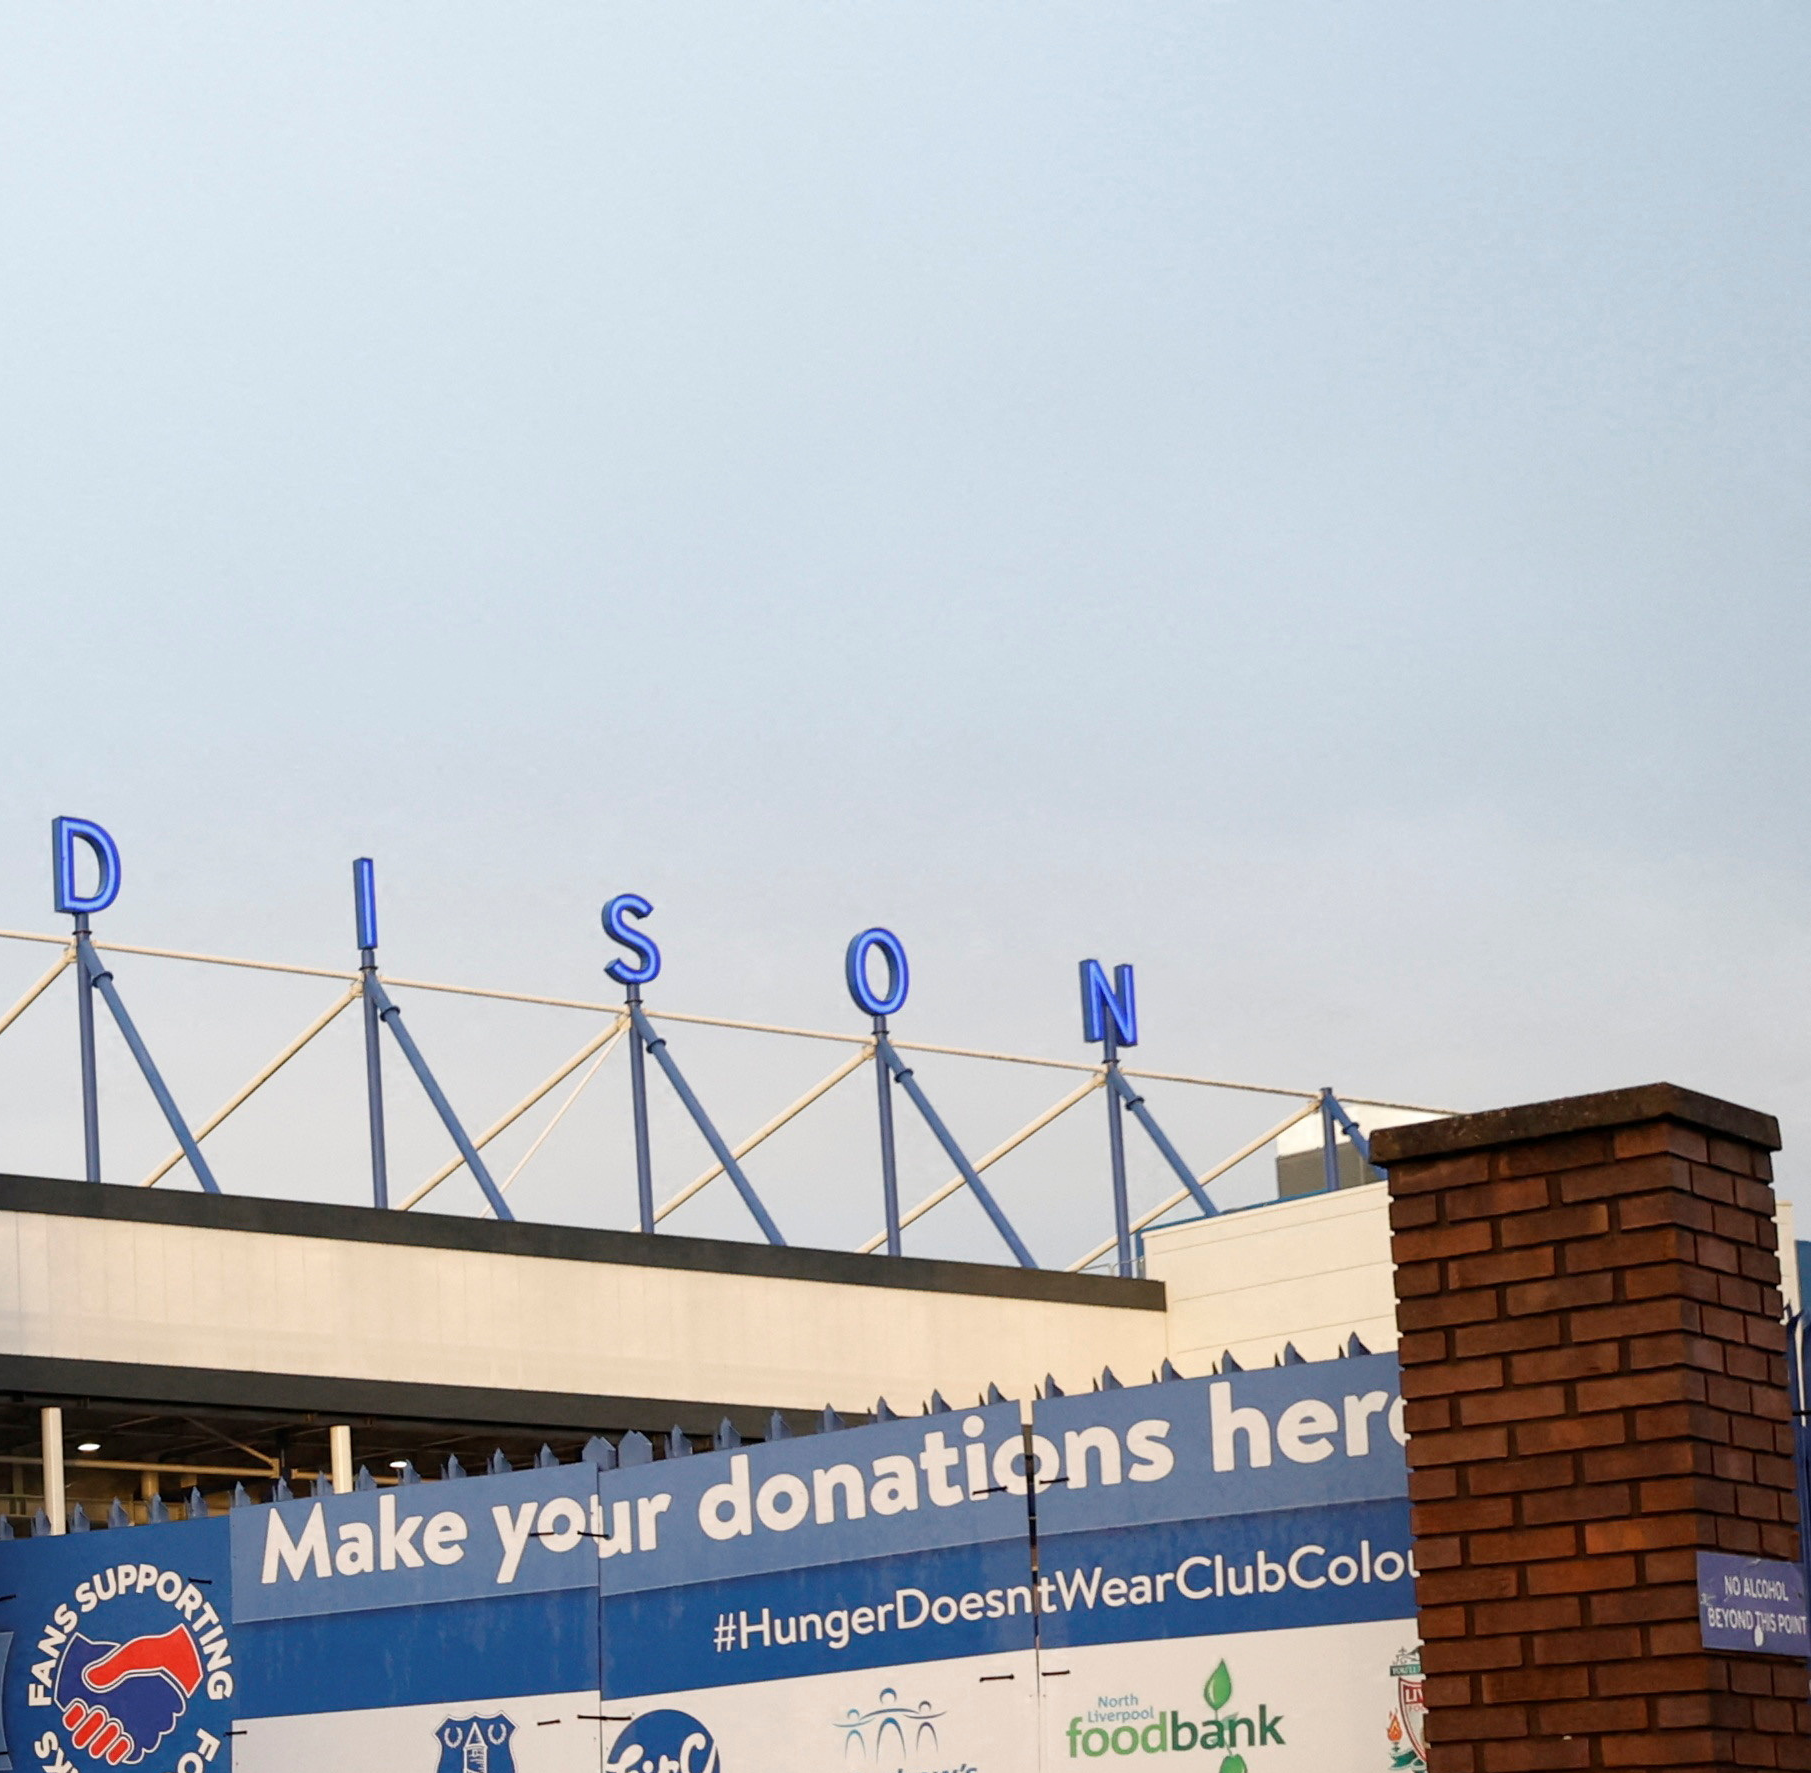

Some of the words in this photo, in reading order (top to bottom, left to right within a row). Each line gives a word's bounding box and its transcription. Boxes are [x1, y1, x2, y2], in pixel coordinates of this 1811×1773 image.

[260, 1494, 468, 1585] Make
[490, 1493, 673, 1584] your
[698, 1414, 1175, 1541] donations
[1724, 1575, 1741, 1596] NO
[1744, 1577, 1789, 1602] ALCOHOL
[28, 1604, 79, 1707] FANS
[75, 1563, 234, 1701] SUPPORTING
[1707, 1607, 1754, 1631] BEYOND
[1755, 1611, 1777, 1633] THIS
[1778, 1614, 1807, 1635] POINT
[1086, 1705, 1156, 1725] Liverpool
[1096, 1693, 1139, 1710] North
[1066, 1704, 1286, 1760] foodbank
